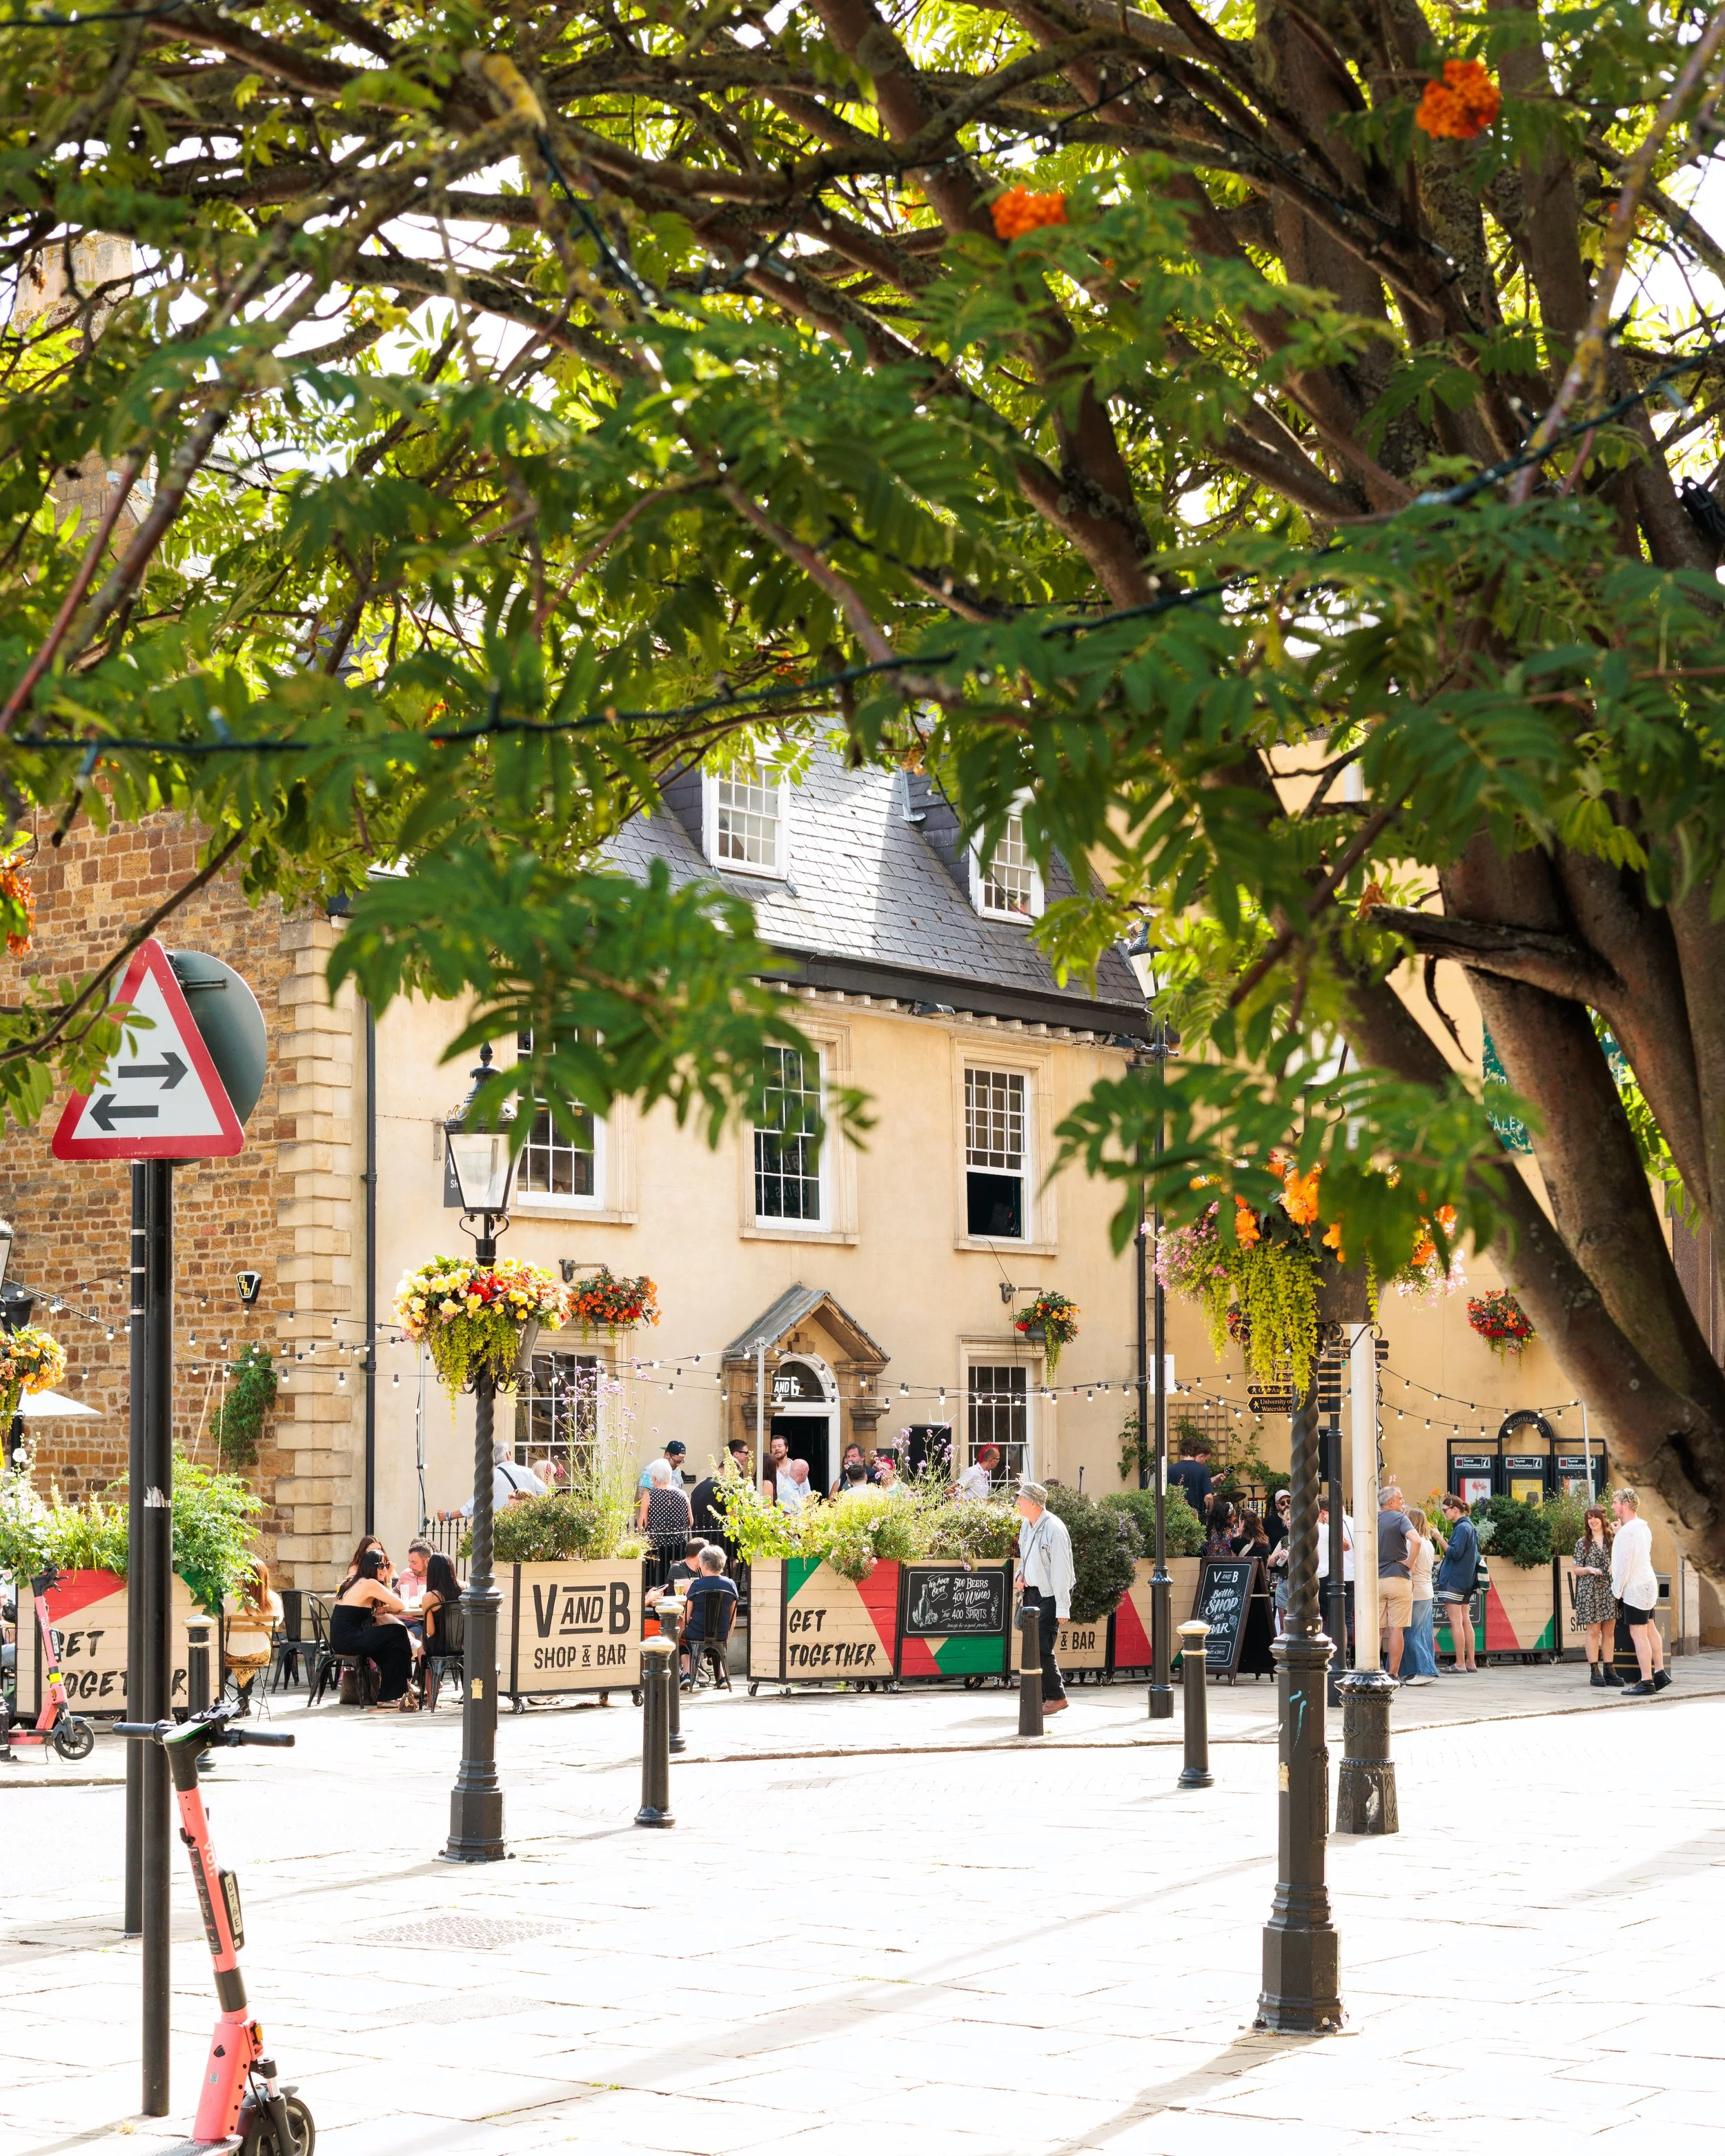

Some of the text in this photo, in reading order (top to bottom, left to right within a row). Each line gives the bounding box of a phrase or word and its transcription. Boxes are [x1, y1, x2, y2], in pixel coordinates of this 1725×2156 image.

[774, 1381, 789, 1393] AND
[953, 1577, 965, 1591] 500
[1214, 1571, 1222, 1583] V
[1232, 1571, 1239, 1583] B
[952, 1589, 991, 1605] 400 Wines
[1211, 1588, 1234, 1599] Bottle
[532, 1582, 631, 1638] V AND B
[1205, 1597, 1239, 1614] SHOP
[789, 1609, 827, 1633] GET
[952, 1609, 964, 1620] 400
[966, 1609, 987, 1621] SPIRITS
[1213, 1613, 1225, 1621] AND
[1208, 1623, 1231, 1634] BAR
[1072, 1631, 1095, 1650] BAR
[534, 1644, 626, 1669] SHOP & BAR
[789, 1643, 876, 1668] TOGETHER
